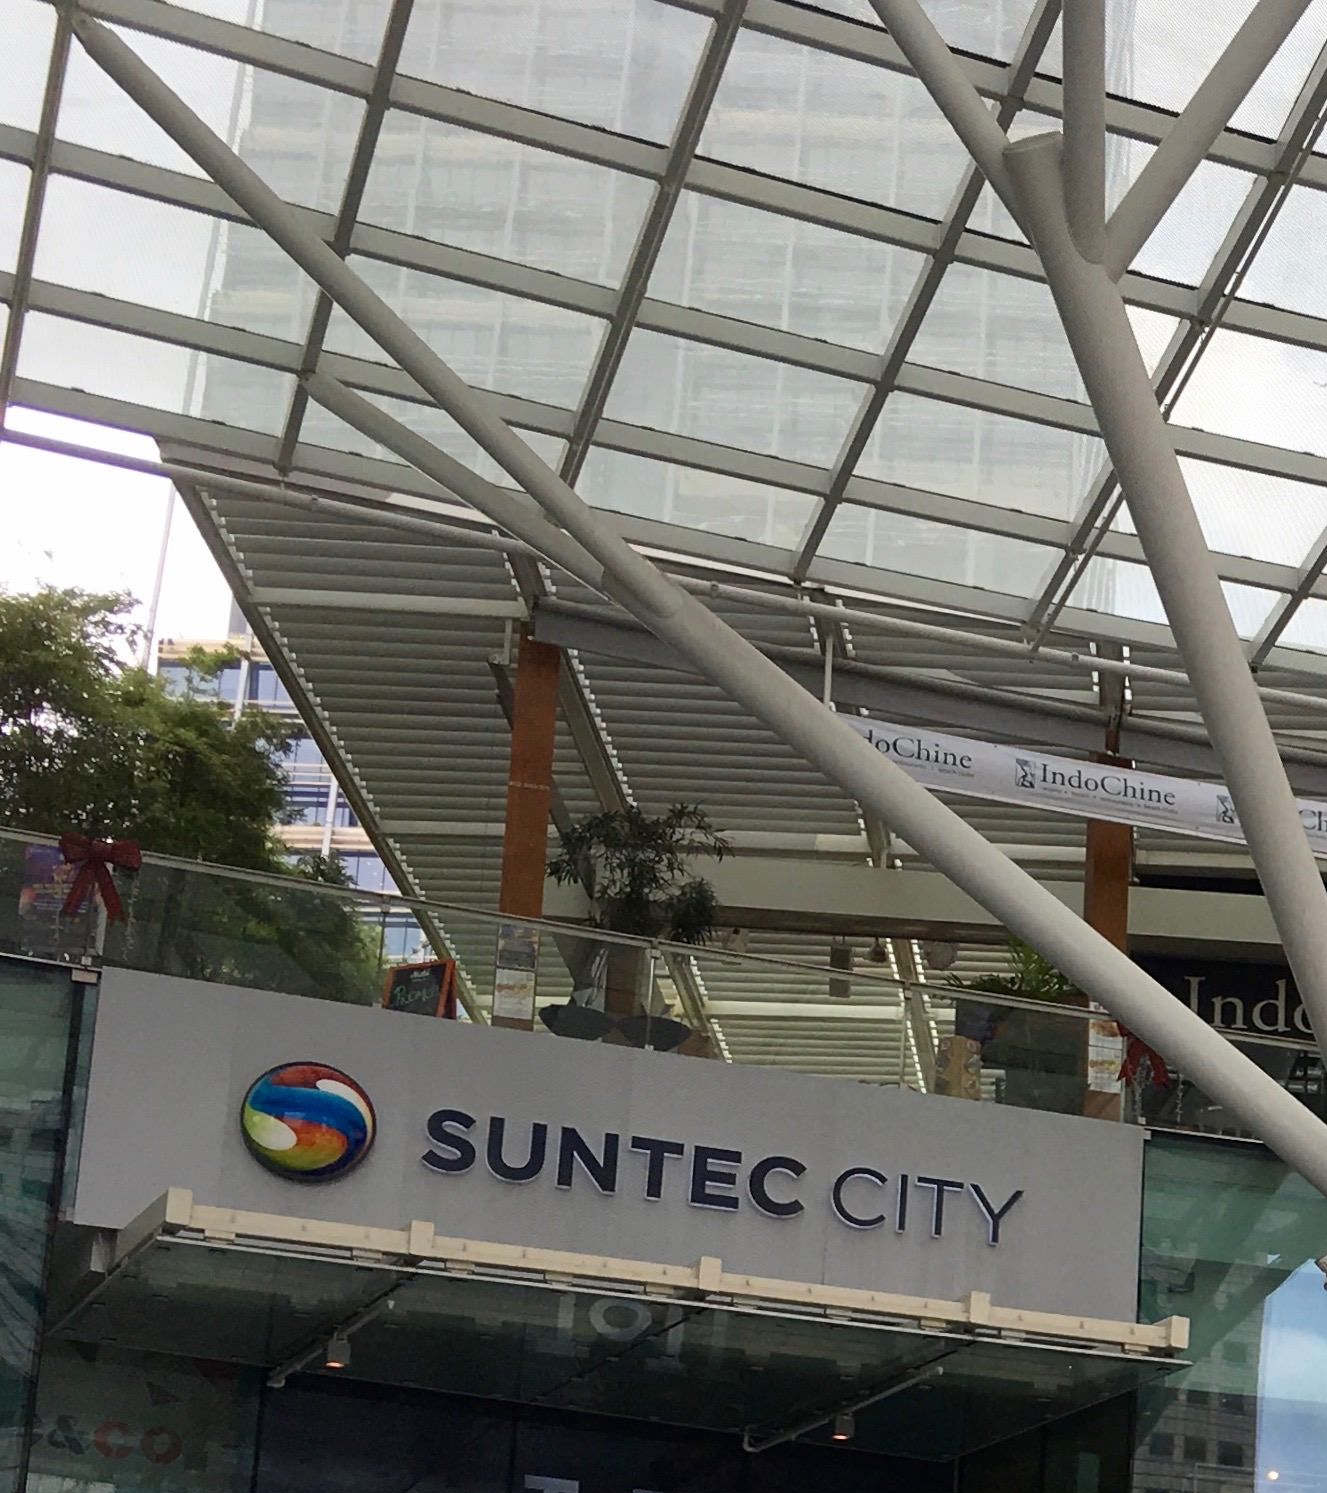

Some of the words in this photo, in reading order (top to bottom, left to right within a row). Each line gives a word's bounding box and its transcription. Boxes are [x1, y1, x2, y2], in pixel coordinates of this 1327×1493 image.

[864, 729, 973, 769] doChine
[1041, 763, 1176, 806] IndoChine
[420, 1108, 806, 1218] SUNTEC
[830, 1166, 1025, 1246] CITY
